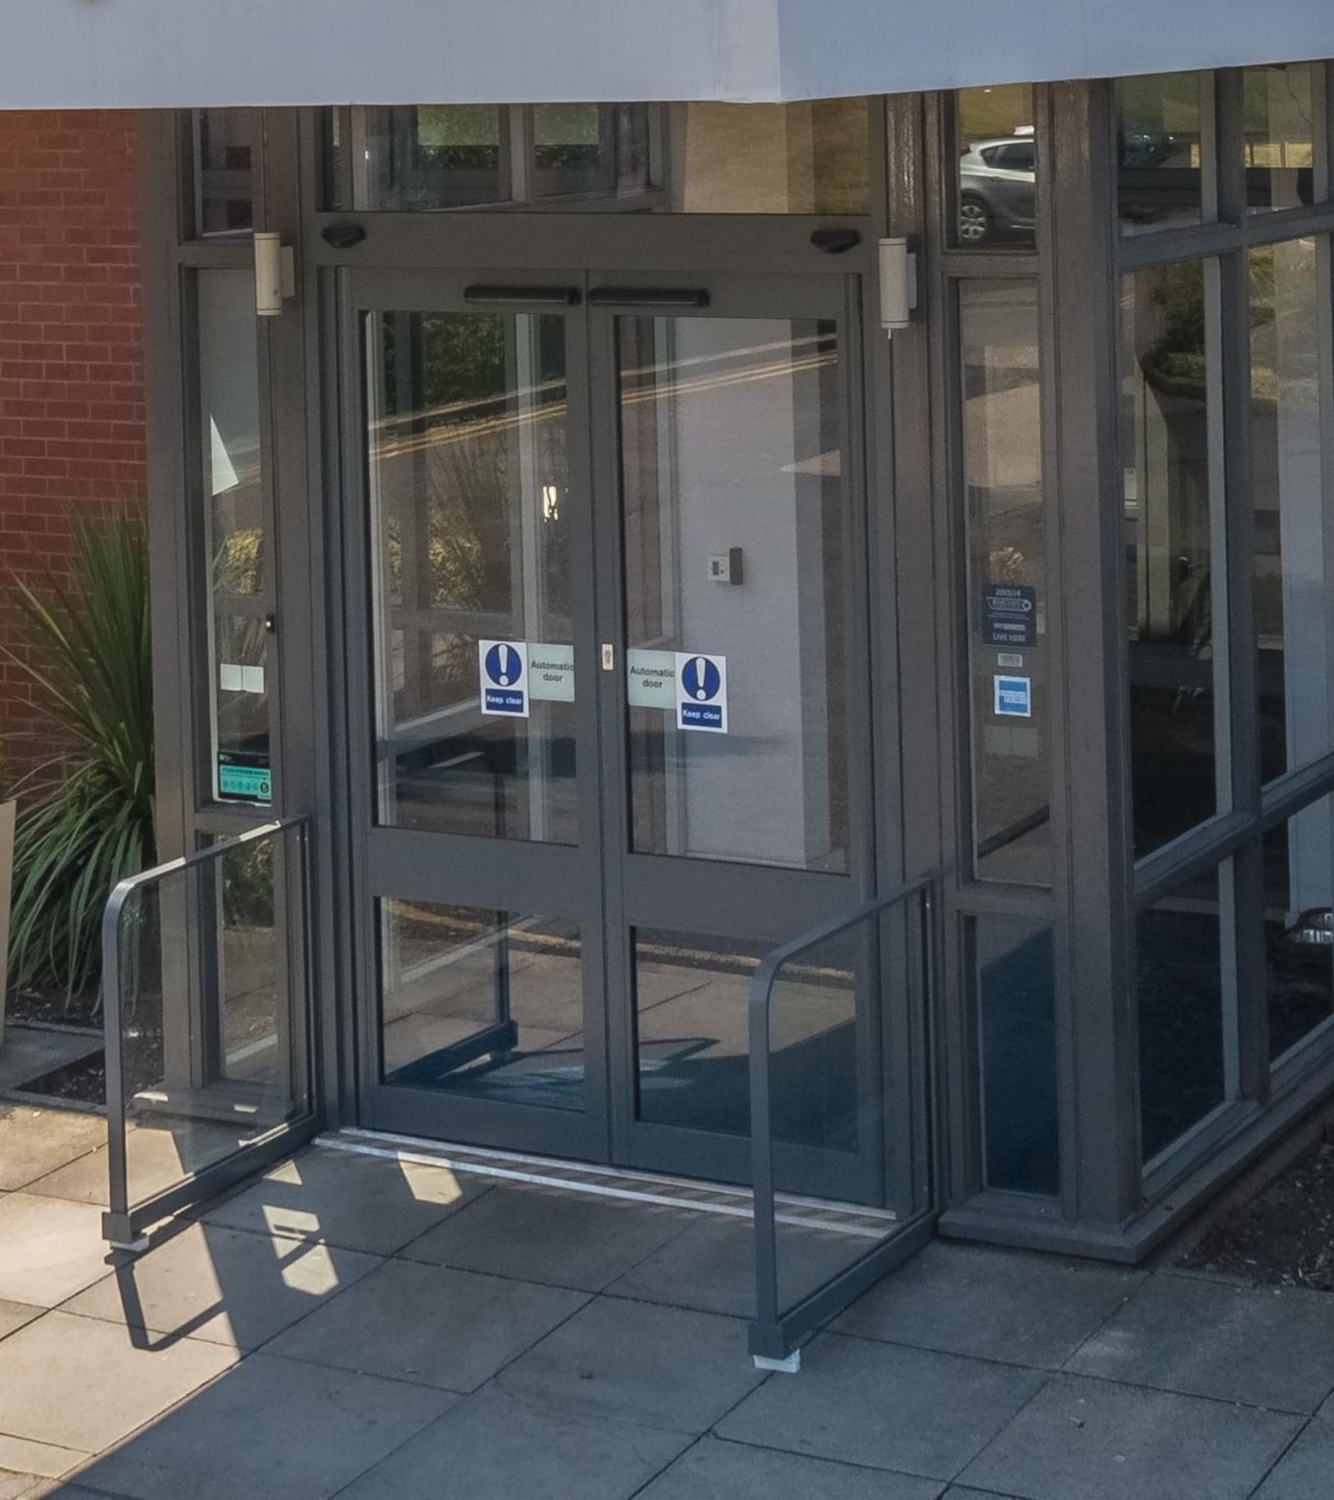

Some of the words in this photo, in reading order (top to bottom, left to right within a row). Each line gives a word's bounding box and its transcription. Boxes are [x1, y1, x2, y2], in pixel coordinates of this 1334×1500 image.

[530, 660, 575, 671] Automatic
[630, 666, 675, 677] Automatic
[543, 673, 563, 682] door
[643, 679, 663, 688] door
[486, 695, 504, 705] Keep
[505, 696, 522, 705] clear
[682, 709, 701, 719] Keep
[703, 711, 720, 720] clear
